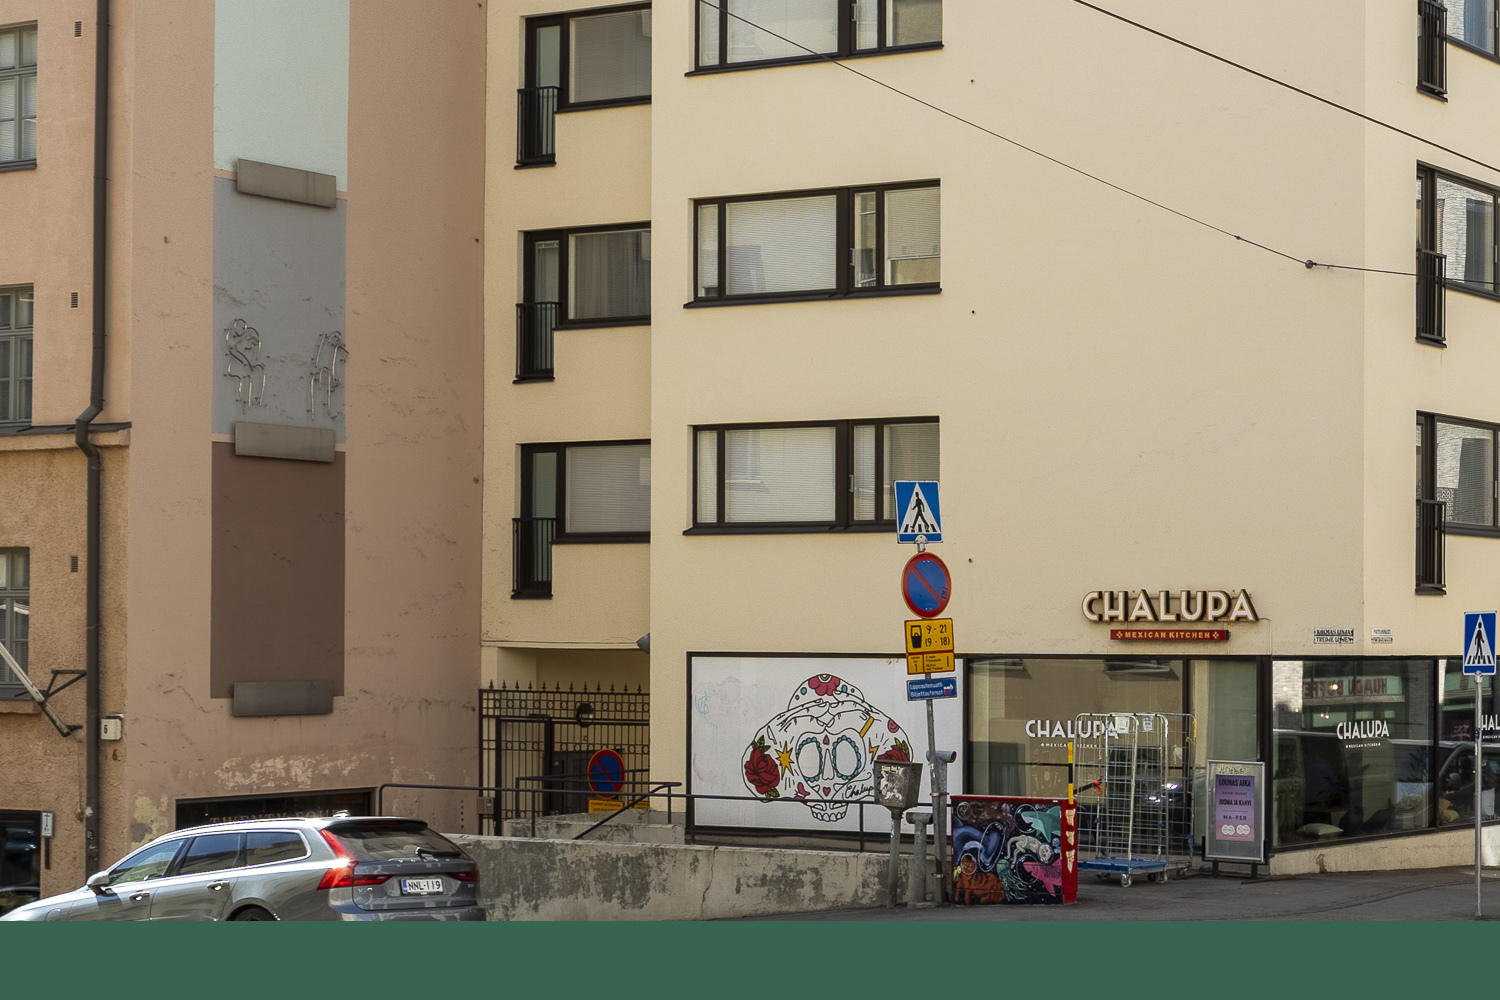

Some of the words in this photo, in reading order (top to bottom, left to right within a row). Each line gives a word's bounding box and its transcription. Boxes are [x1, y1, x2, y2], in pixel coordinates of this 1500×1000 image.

[1082, 589, 1259, 622] CHALUPA
[1124, 631, 1167, 639] MEXICAN
[1169, 631, 1211, 639] KITCHEN
[103, 724, 109, 734] 6
[1025, 719, 1119, 739] CHALUPA
[1336, 720, 1390, 740] CHALUPA
[845, 783, 875, 799] Chalup
[408, 880, 441, 891] NNL-119
